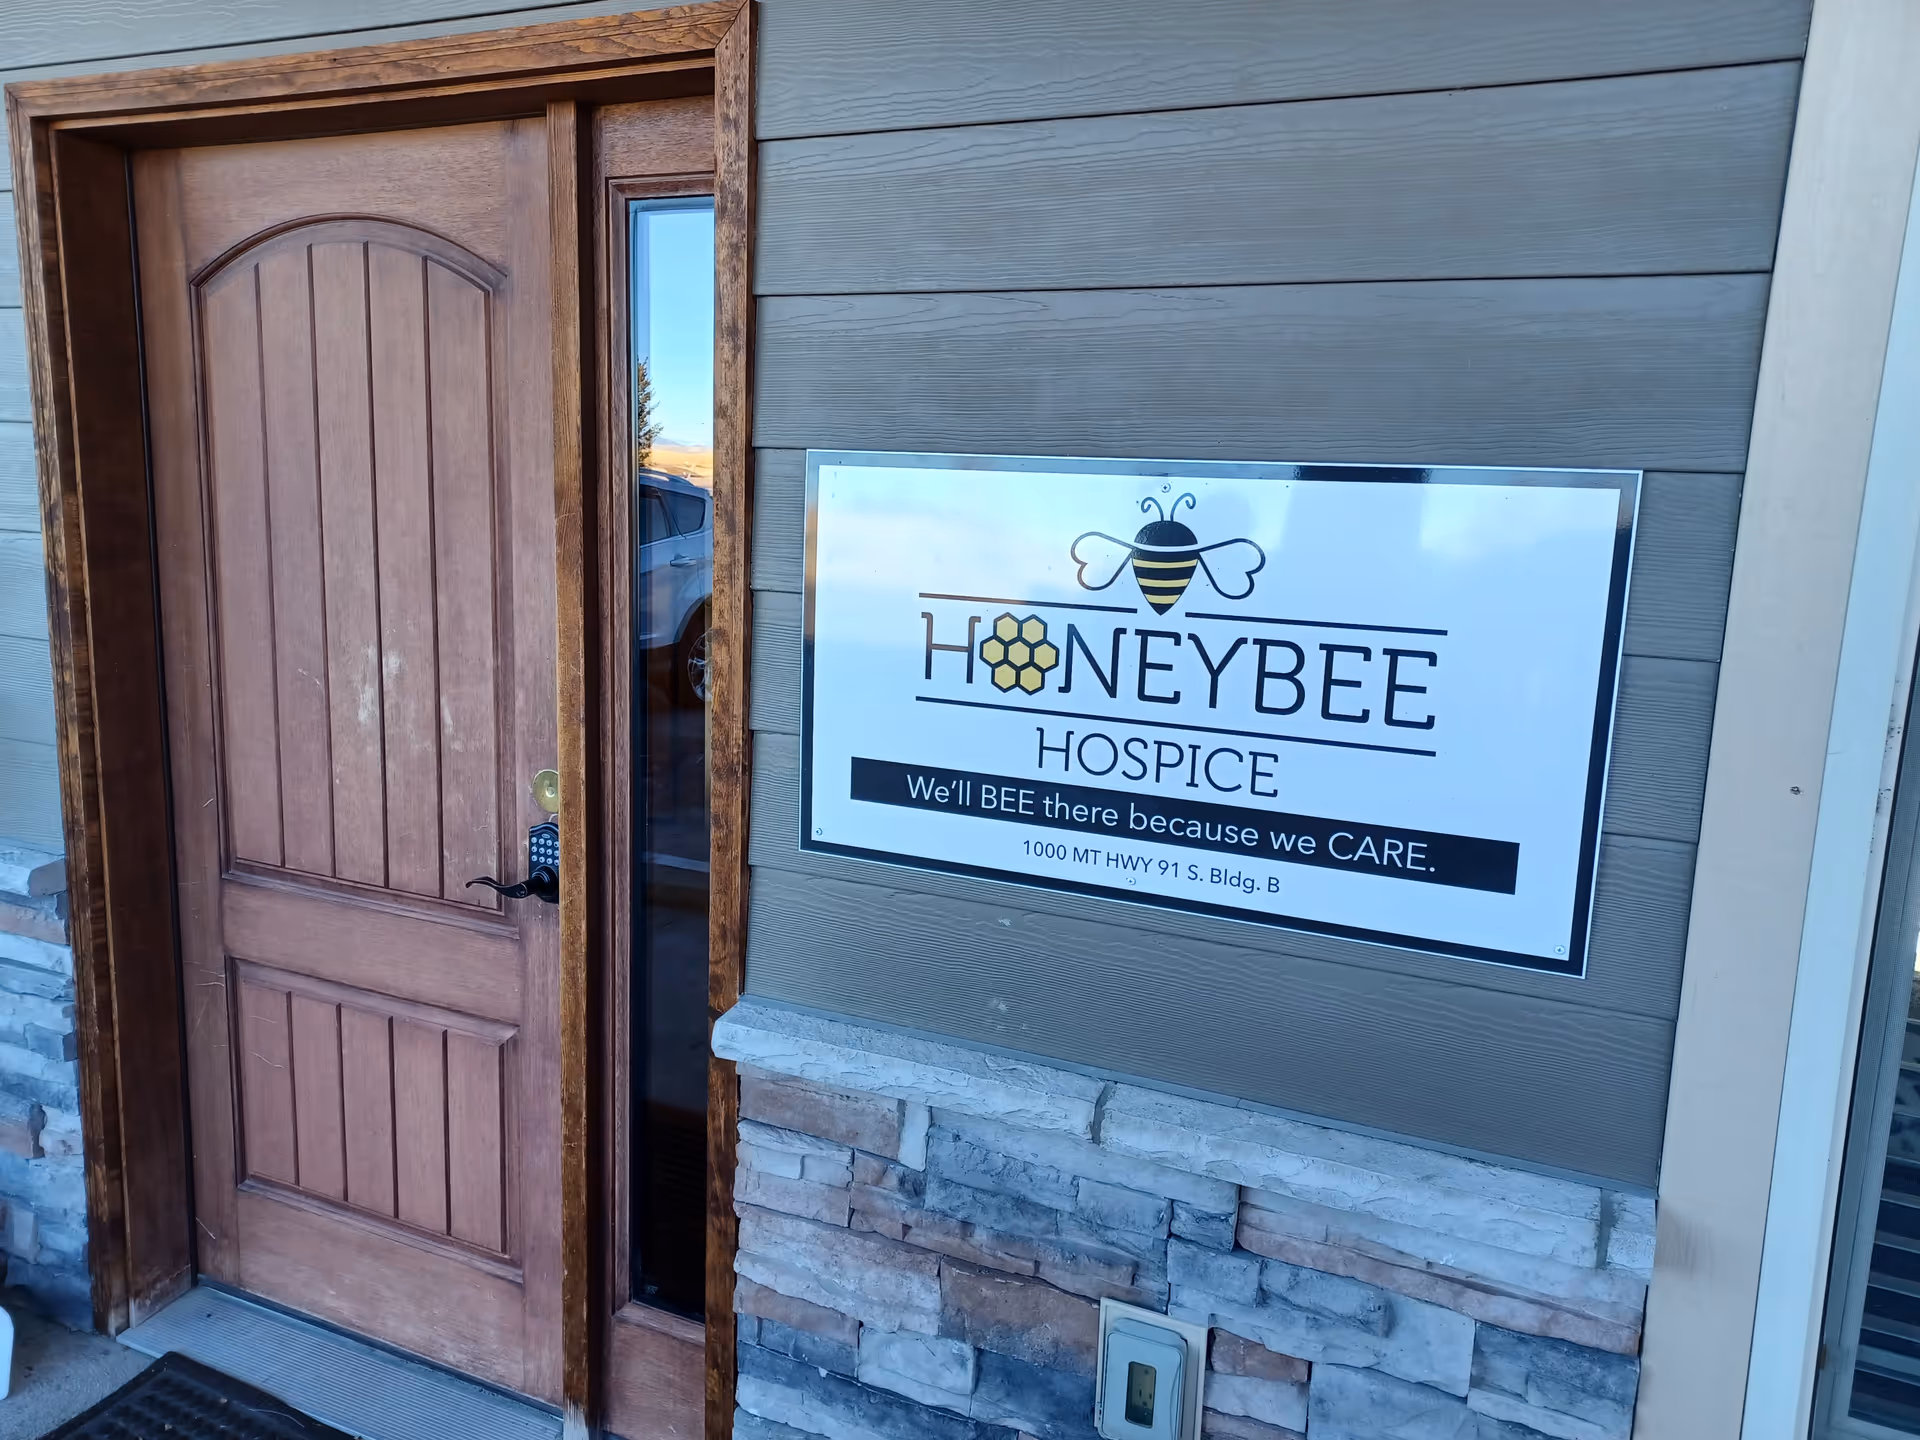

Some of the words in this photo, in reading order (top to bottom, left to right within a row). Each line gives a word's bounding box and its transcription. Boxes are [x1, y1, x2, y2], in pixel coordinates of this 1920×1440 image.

[921, 611, 1438, 730] HONEYBEE
[1036, 727, 1279, 798] HOSPICE
[906, 774, 971, 806] We'll
[981, 784, 1035, 816] BEE
[1042, 792, 1119, 827] there
[1129, 802, 1259, 846] because
[1270, 830, 1317, 855] we
[1328, 832, 1436, 873] CARE.
[1023, 839, 1067, 861] 1000
[1072, 846, 1102, 866] MT
[1106, 851, 1153, 874] HWY
[1158, 859, 1179, 878] 91
[1187, 864, 1204, 882] S.
[1210, 867, 1261, 894] Bldg.
[1267, 876, 1280, 893] B
